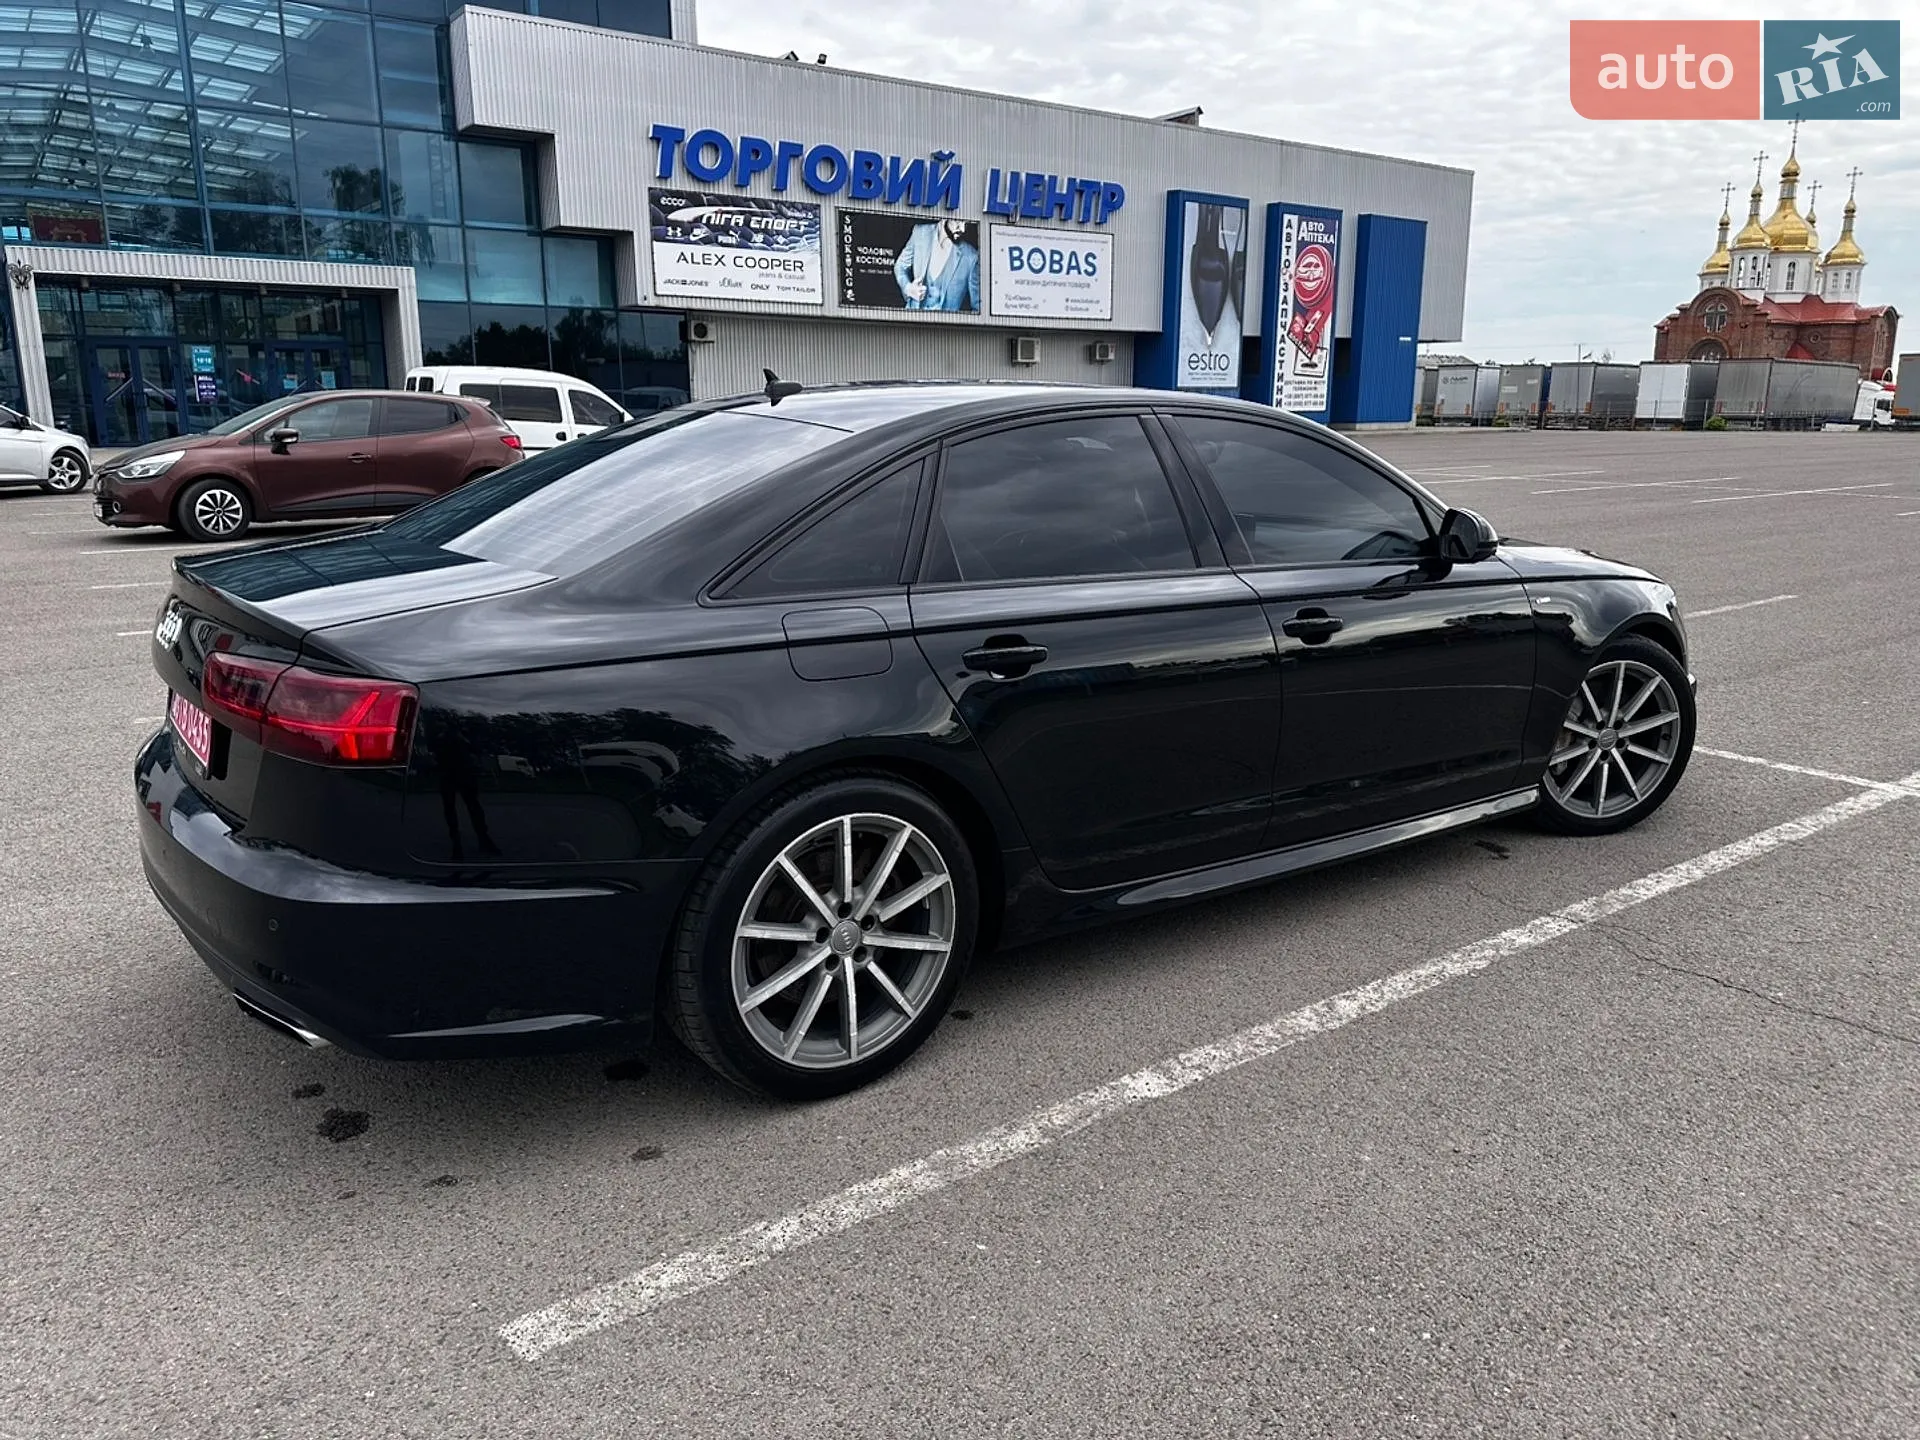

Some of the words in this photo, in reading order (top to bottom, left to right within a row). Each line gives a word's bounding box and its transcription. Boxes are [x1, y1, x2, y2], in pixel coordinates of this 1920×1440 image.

[648, 123, 963, 210] ТОРГОВИЙ
[983, 167, 1126, 225] ЦЕНТР
[676, 251, 726, 267] ALEX
[733, 255, 804, 272] COOPER
[1008, 246, 1097, 277] BOBAS
[1188, 350, 1231, 371] estro
